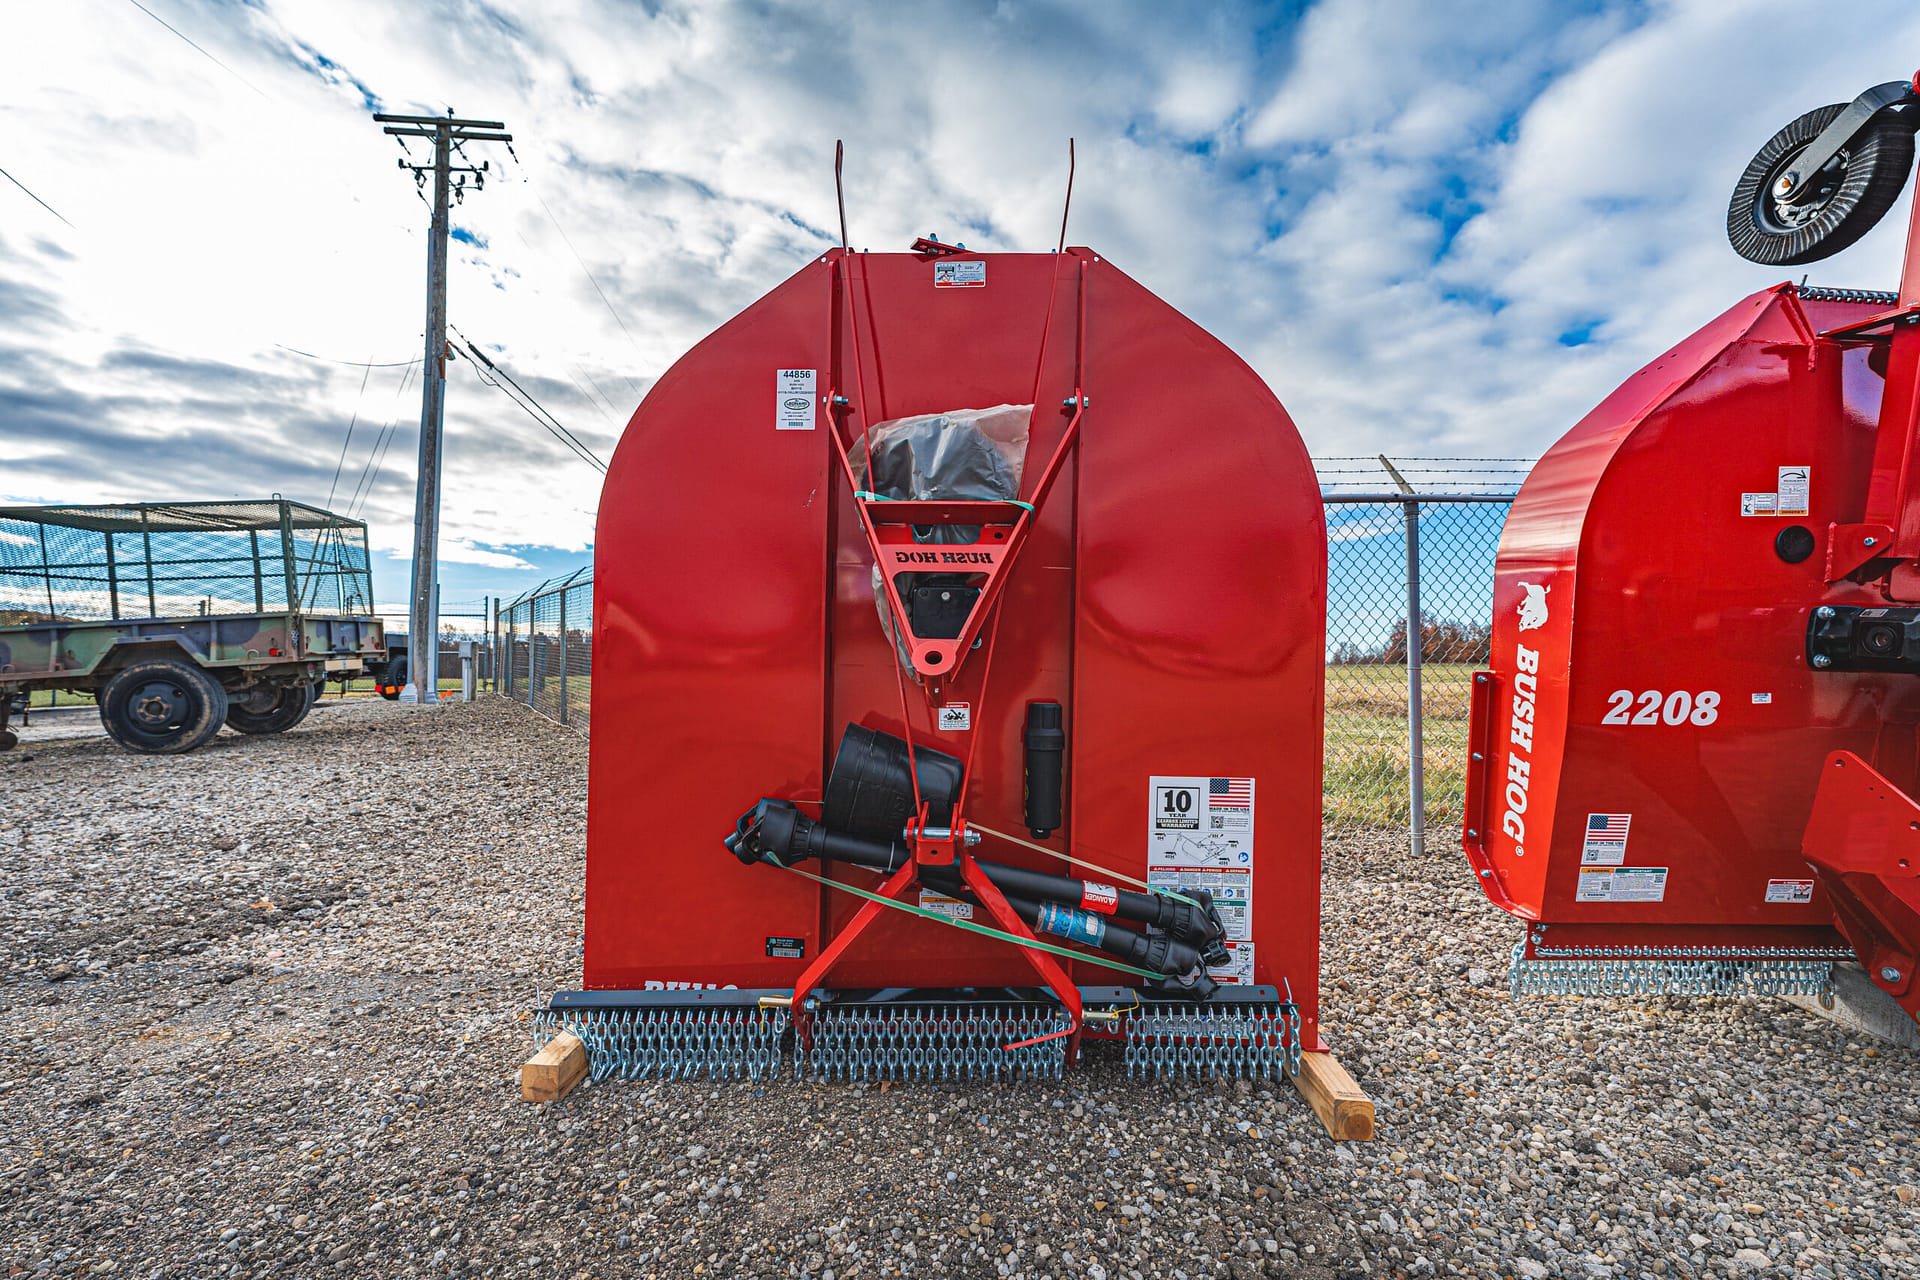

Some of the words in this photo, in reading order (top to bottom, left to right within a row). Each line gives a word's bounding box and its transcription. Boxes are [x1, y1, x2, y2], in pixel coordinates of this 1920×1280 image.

[783, 370, 811, 379] 44856
[1511, 643, 1540, 753] BUSH
[1601, 690, 1721, 726] 2208
[1164, 790, 1192, 813] 10
[1084, 892, 1108, 904] DANGER
